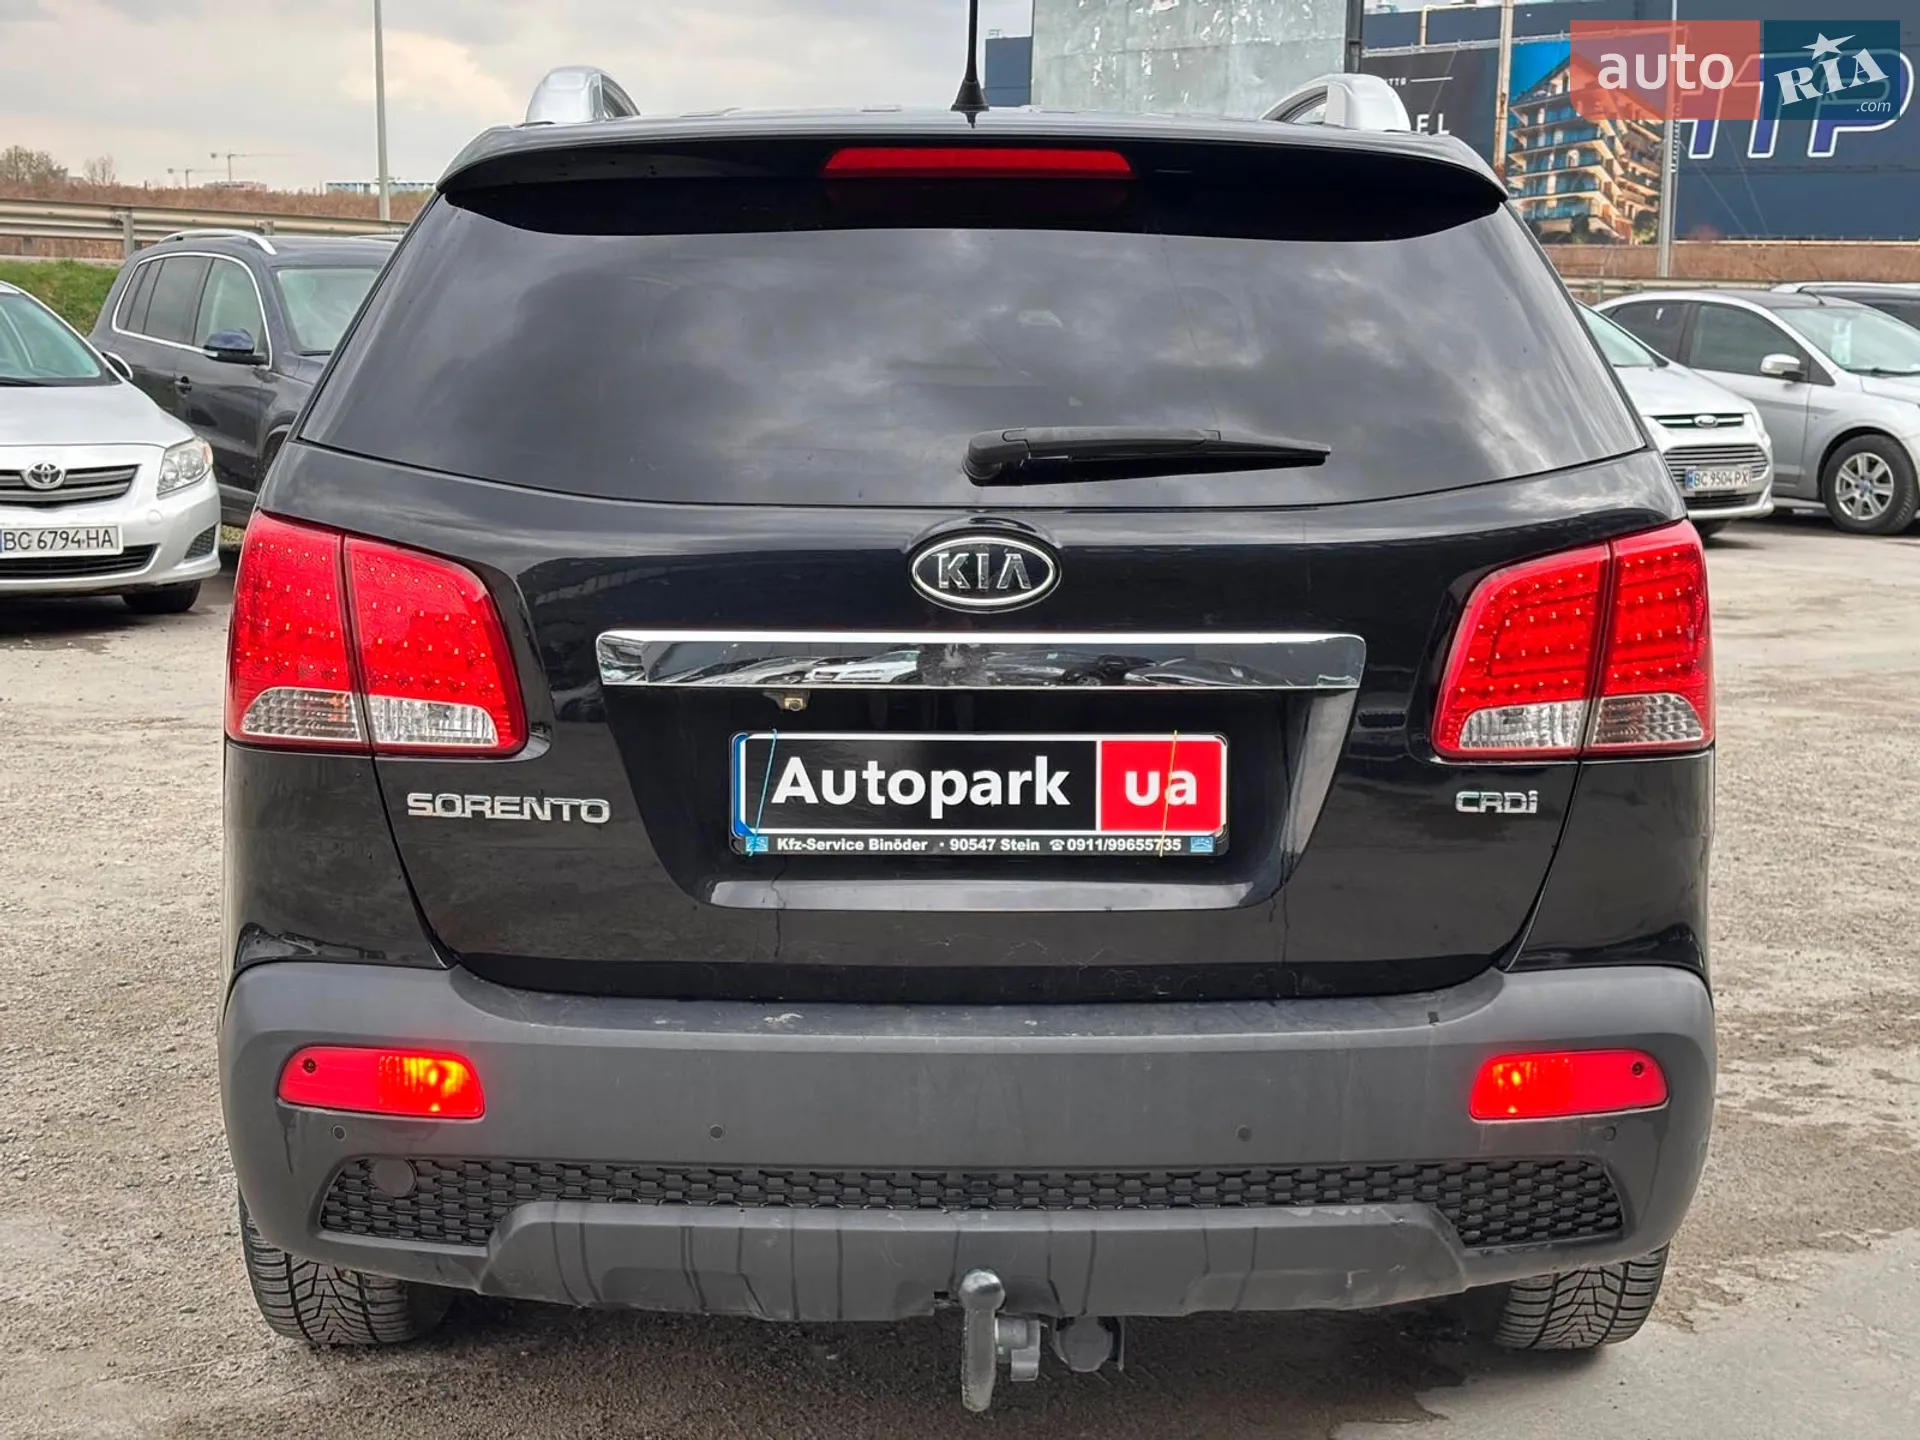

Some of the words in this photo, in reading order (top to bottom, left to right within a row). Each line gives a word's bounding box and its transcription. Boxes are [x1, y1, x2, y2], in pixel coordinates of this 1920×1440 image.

[3, 531, 32, 551] BC
[36, 529, 81, 550] 6794
[86, 529, 114, 548] HA
[932, 552, 1032, 590] KIA
[770, 755, 1071, 819] Autopark
[1125, 770, 1198, 806] ua
[406, 792, 611, 824] SORENTO
[1455, 789, 1539, 814] CRDi
[776, 837, 865, 851] Kfz-Service
[868, 837, 928, 852] Binöder
[949, 838, 997, 852] 90547
[999, 838, 1040, 852] Stein
